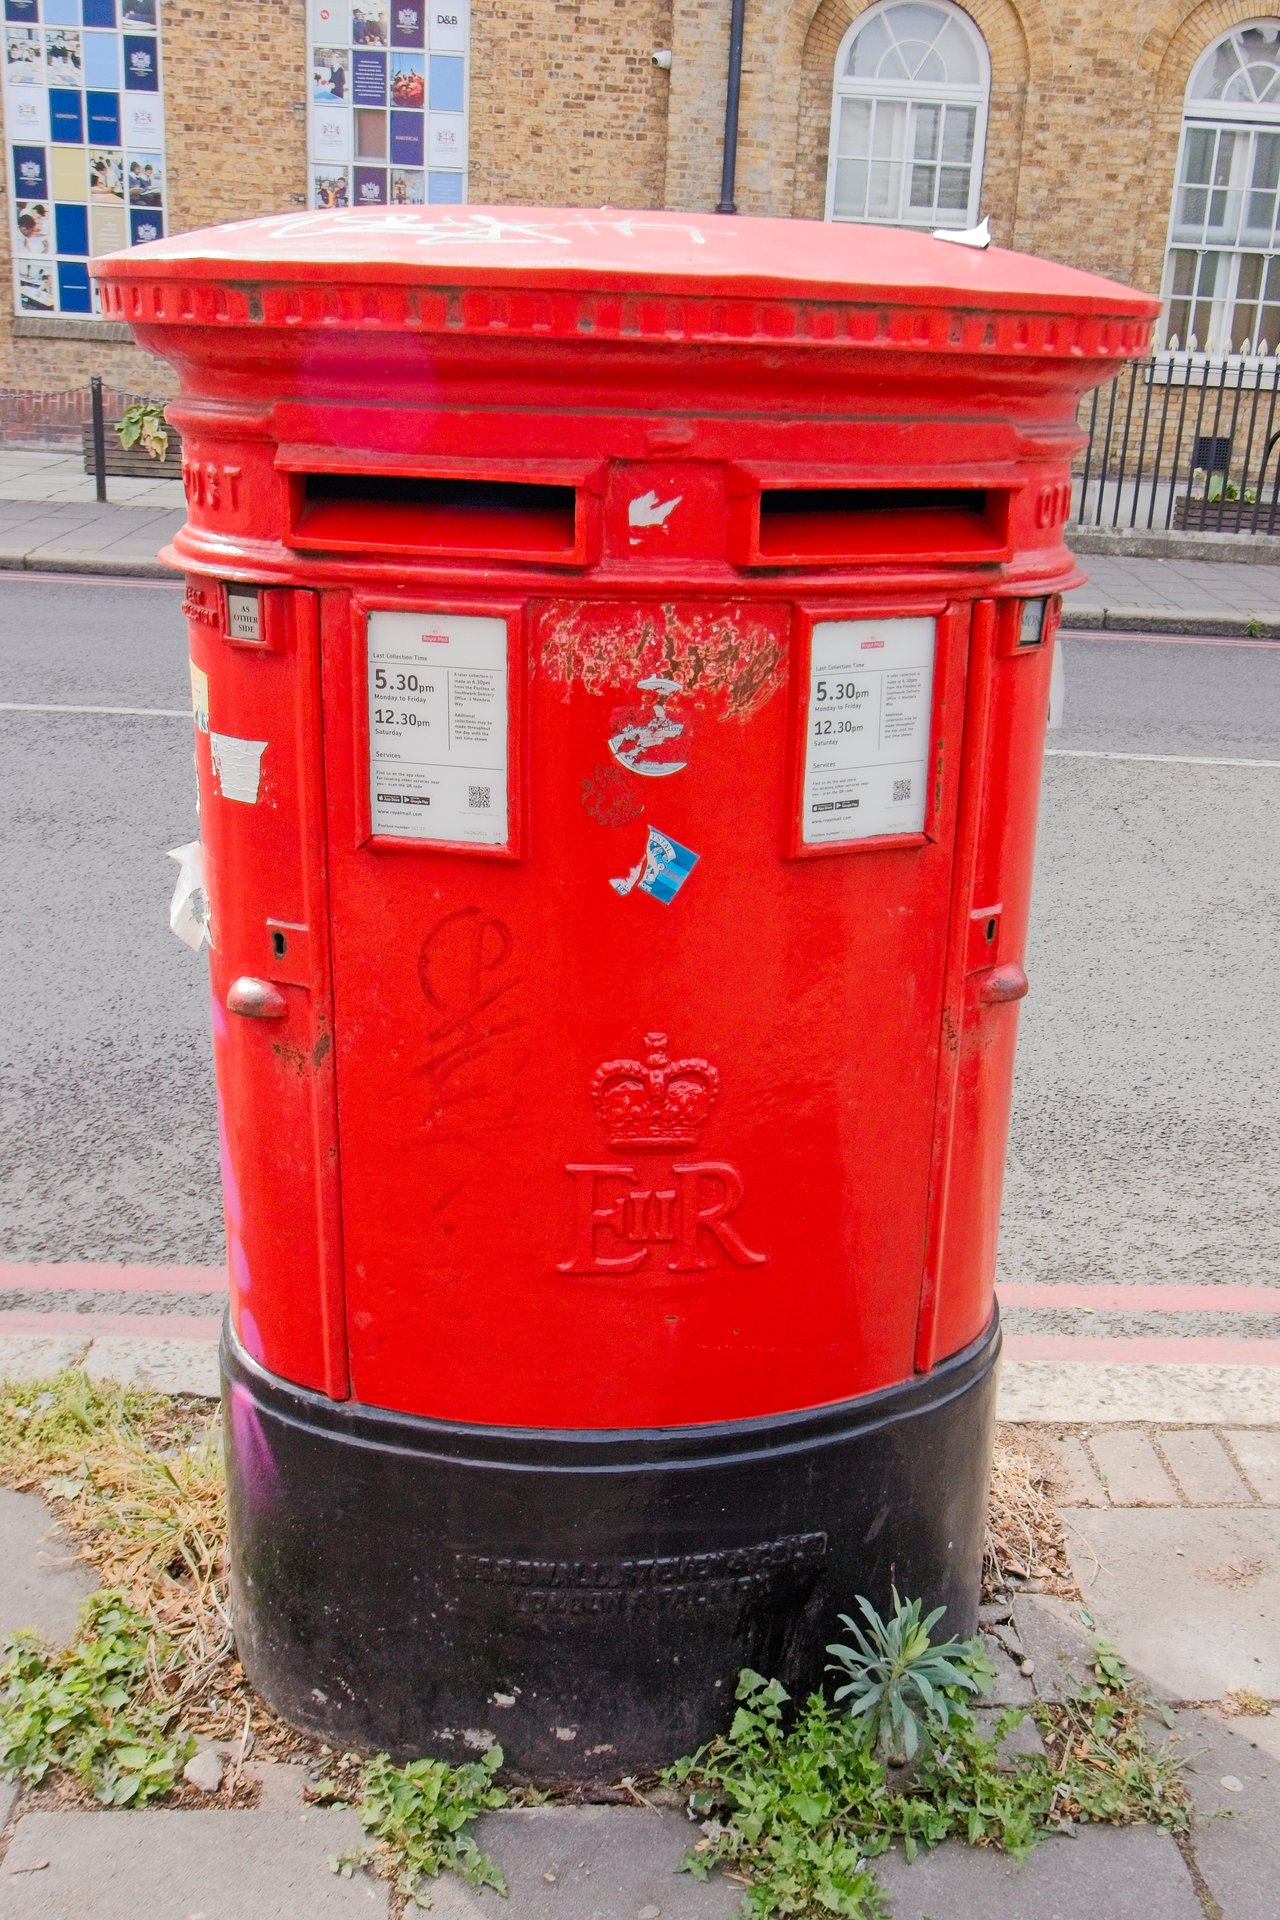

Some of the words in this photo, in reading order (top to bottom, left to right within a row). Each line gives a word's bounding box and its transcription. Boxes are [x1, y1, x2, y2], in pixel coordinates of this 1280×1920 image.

[234, 614, 258, 623] OTHER
[238, 624, 255, 633] SIDE
[376, 669, 434, 694] 5.30pm
[816, 682, 869, 701] 5.30pm
[375, 709, 430, 728] 12.30pm
[376, 728, 402, 737] Saturday
[814, 720, 864, 736] 12.30pm
